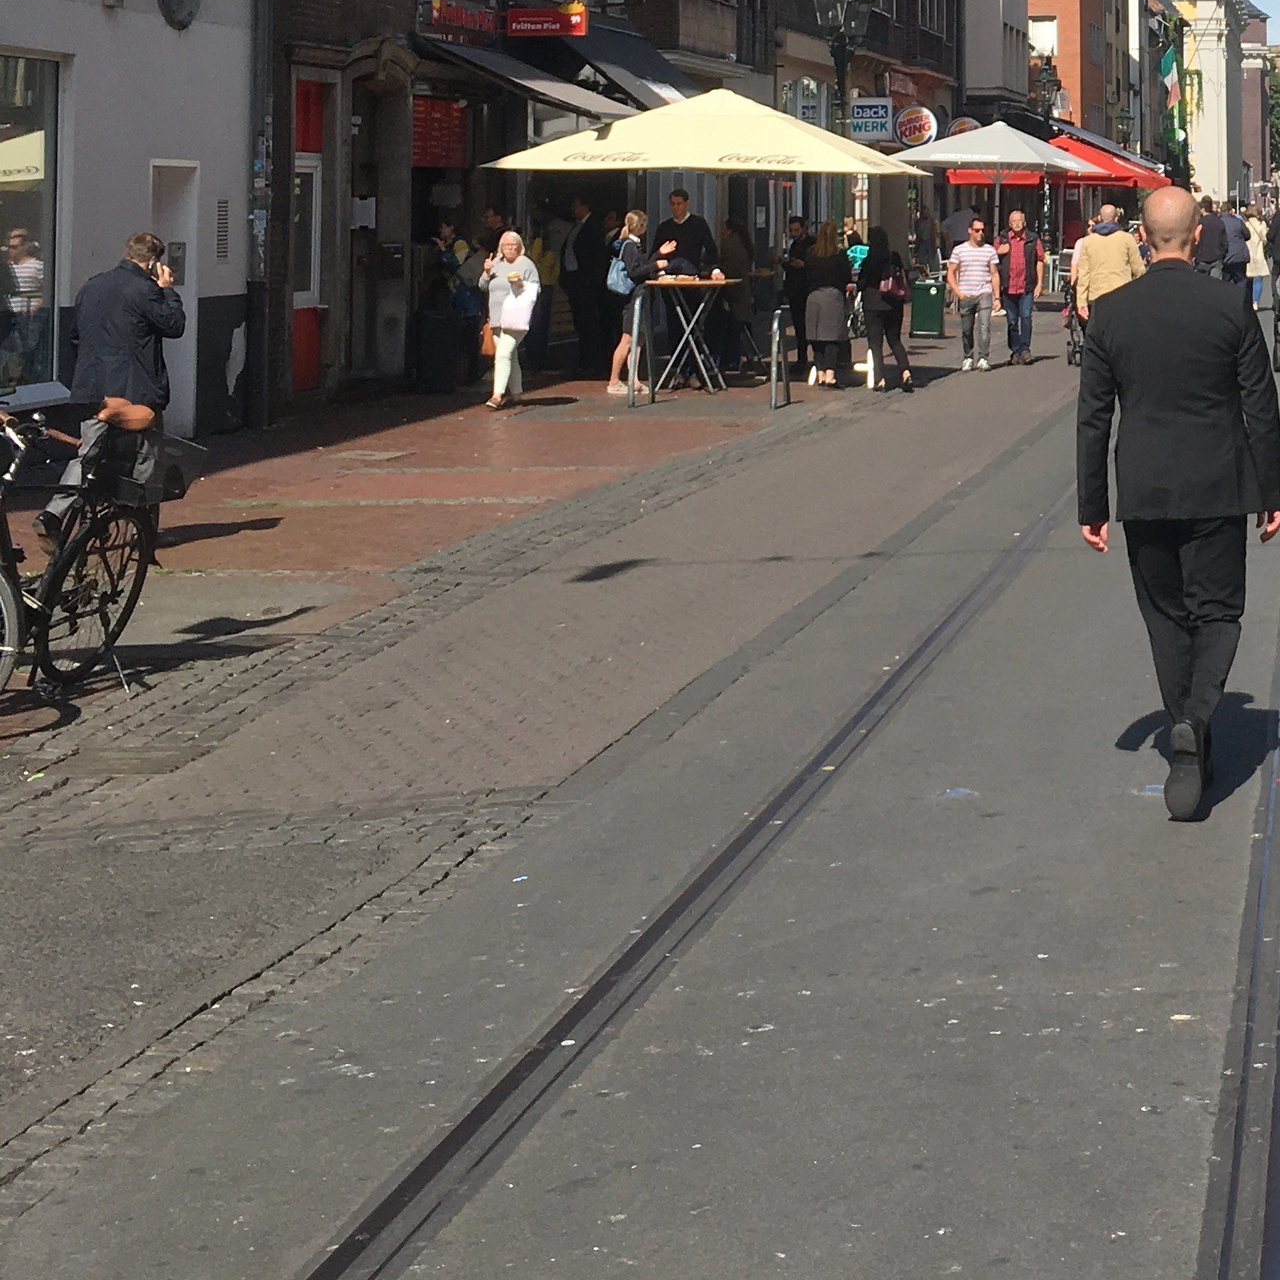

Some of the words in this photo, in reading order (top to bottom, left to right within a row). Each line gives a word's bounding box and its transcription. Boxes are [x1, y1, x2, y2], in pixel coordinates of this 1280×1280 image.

[512, 22, 542, 30] Fritten
[853, 106, 887, 118] back
[852, 121, 889, 132] WERK
[898, 114, 930, 130] BURGER
[899, 122, 932, 140] KING
